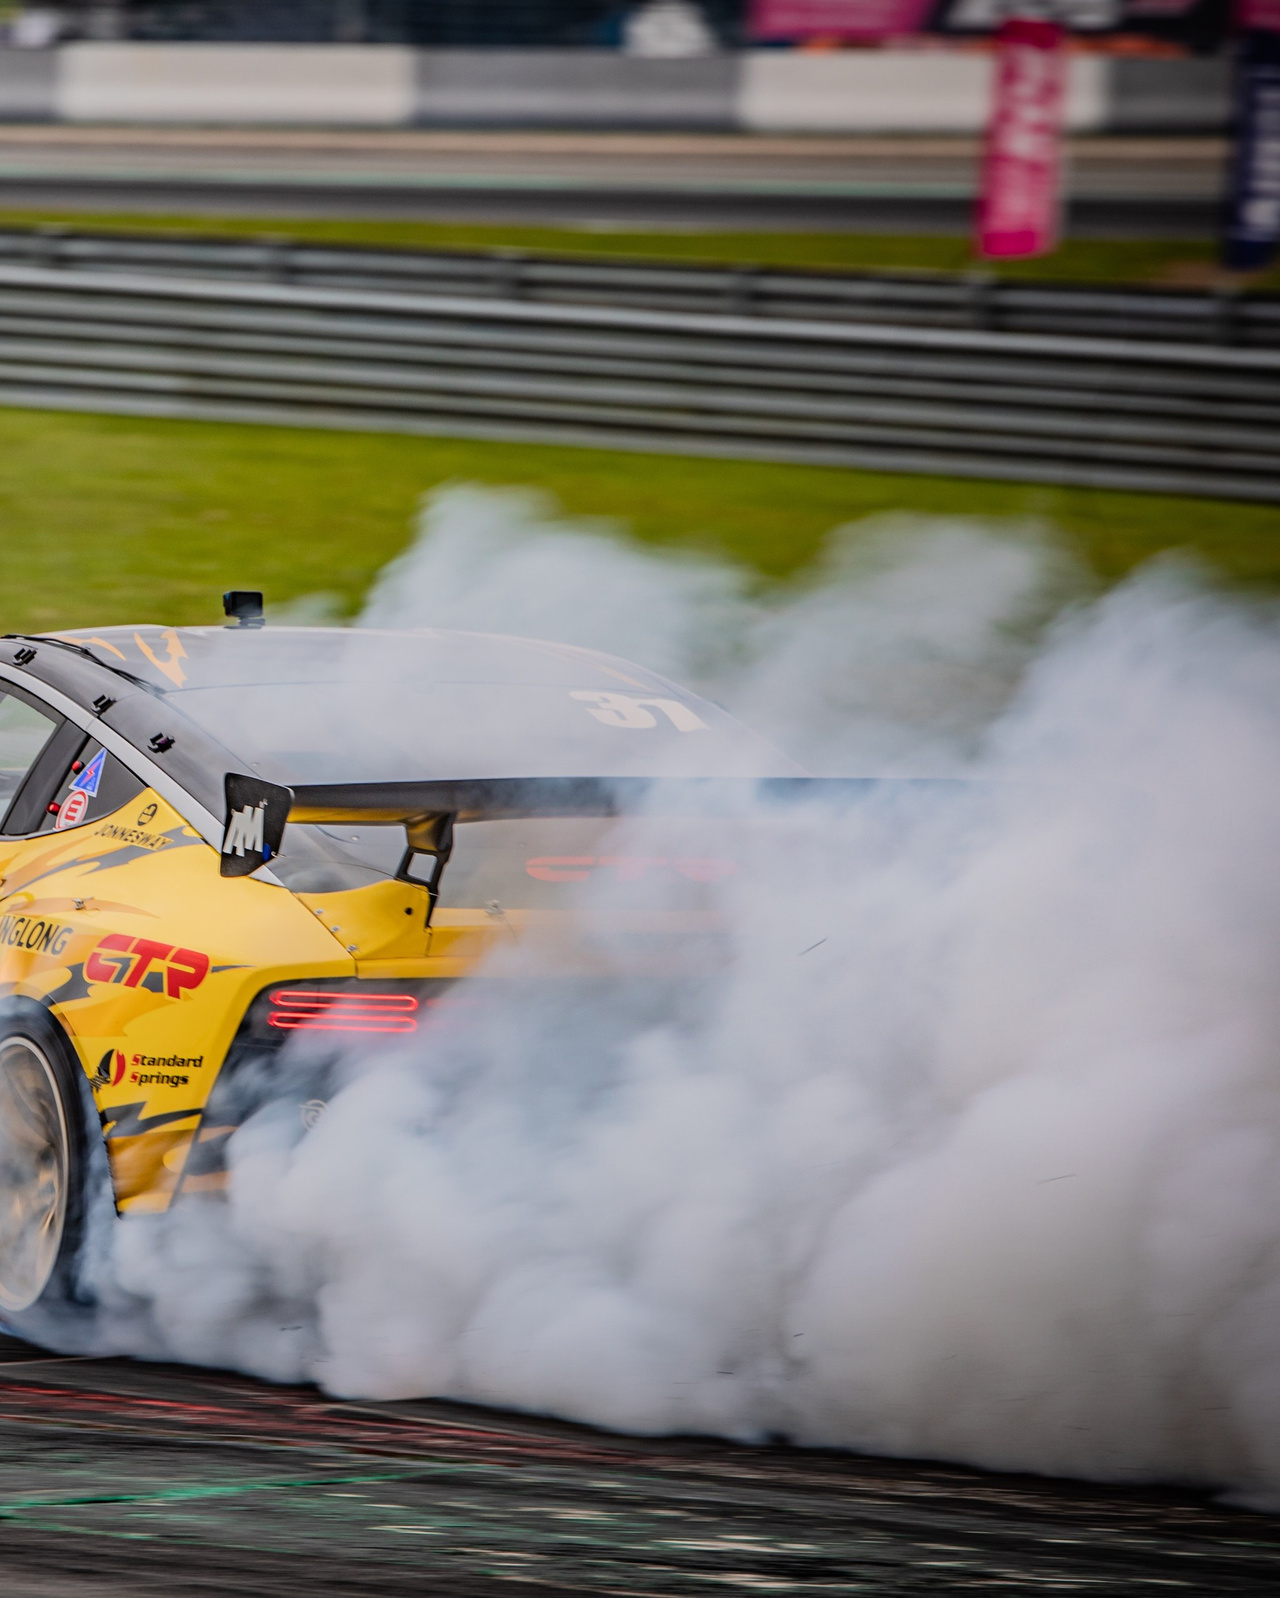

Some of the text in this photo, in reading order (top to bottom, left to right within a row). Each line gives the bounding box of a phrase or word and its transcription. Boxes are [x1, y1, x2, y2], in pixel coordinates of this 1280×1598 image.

[94, 822, 167, 851] JONNESWAY
[130, 1054, 204, 1068] Standard
[129, 1072, 190, 1087] Springs
